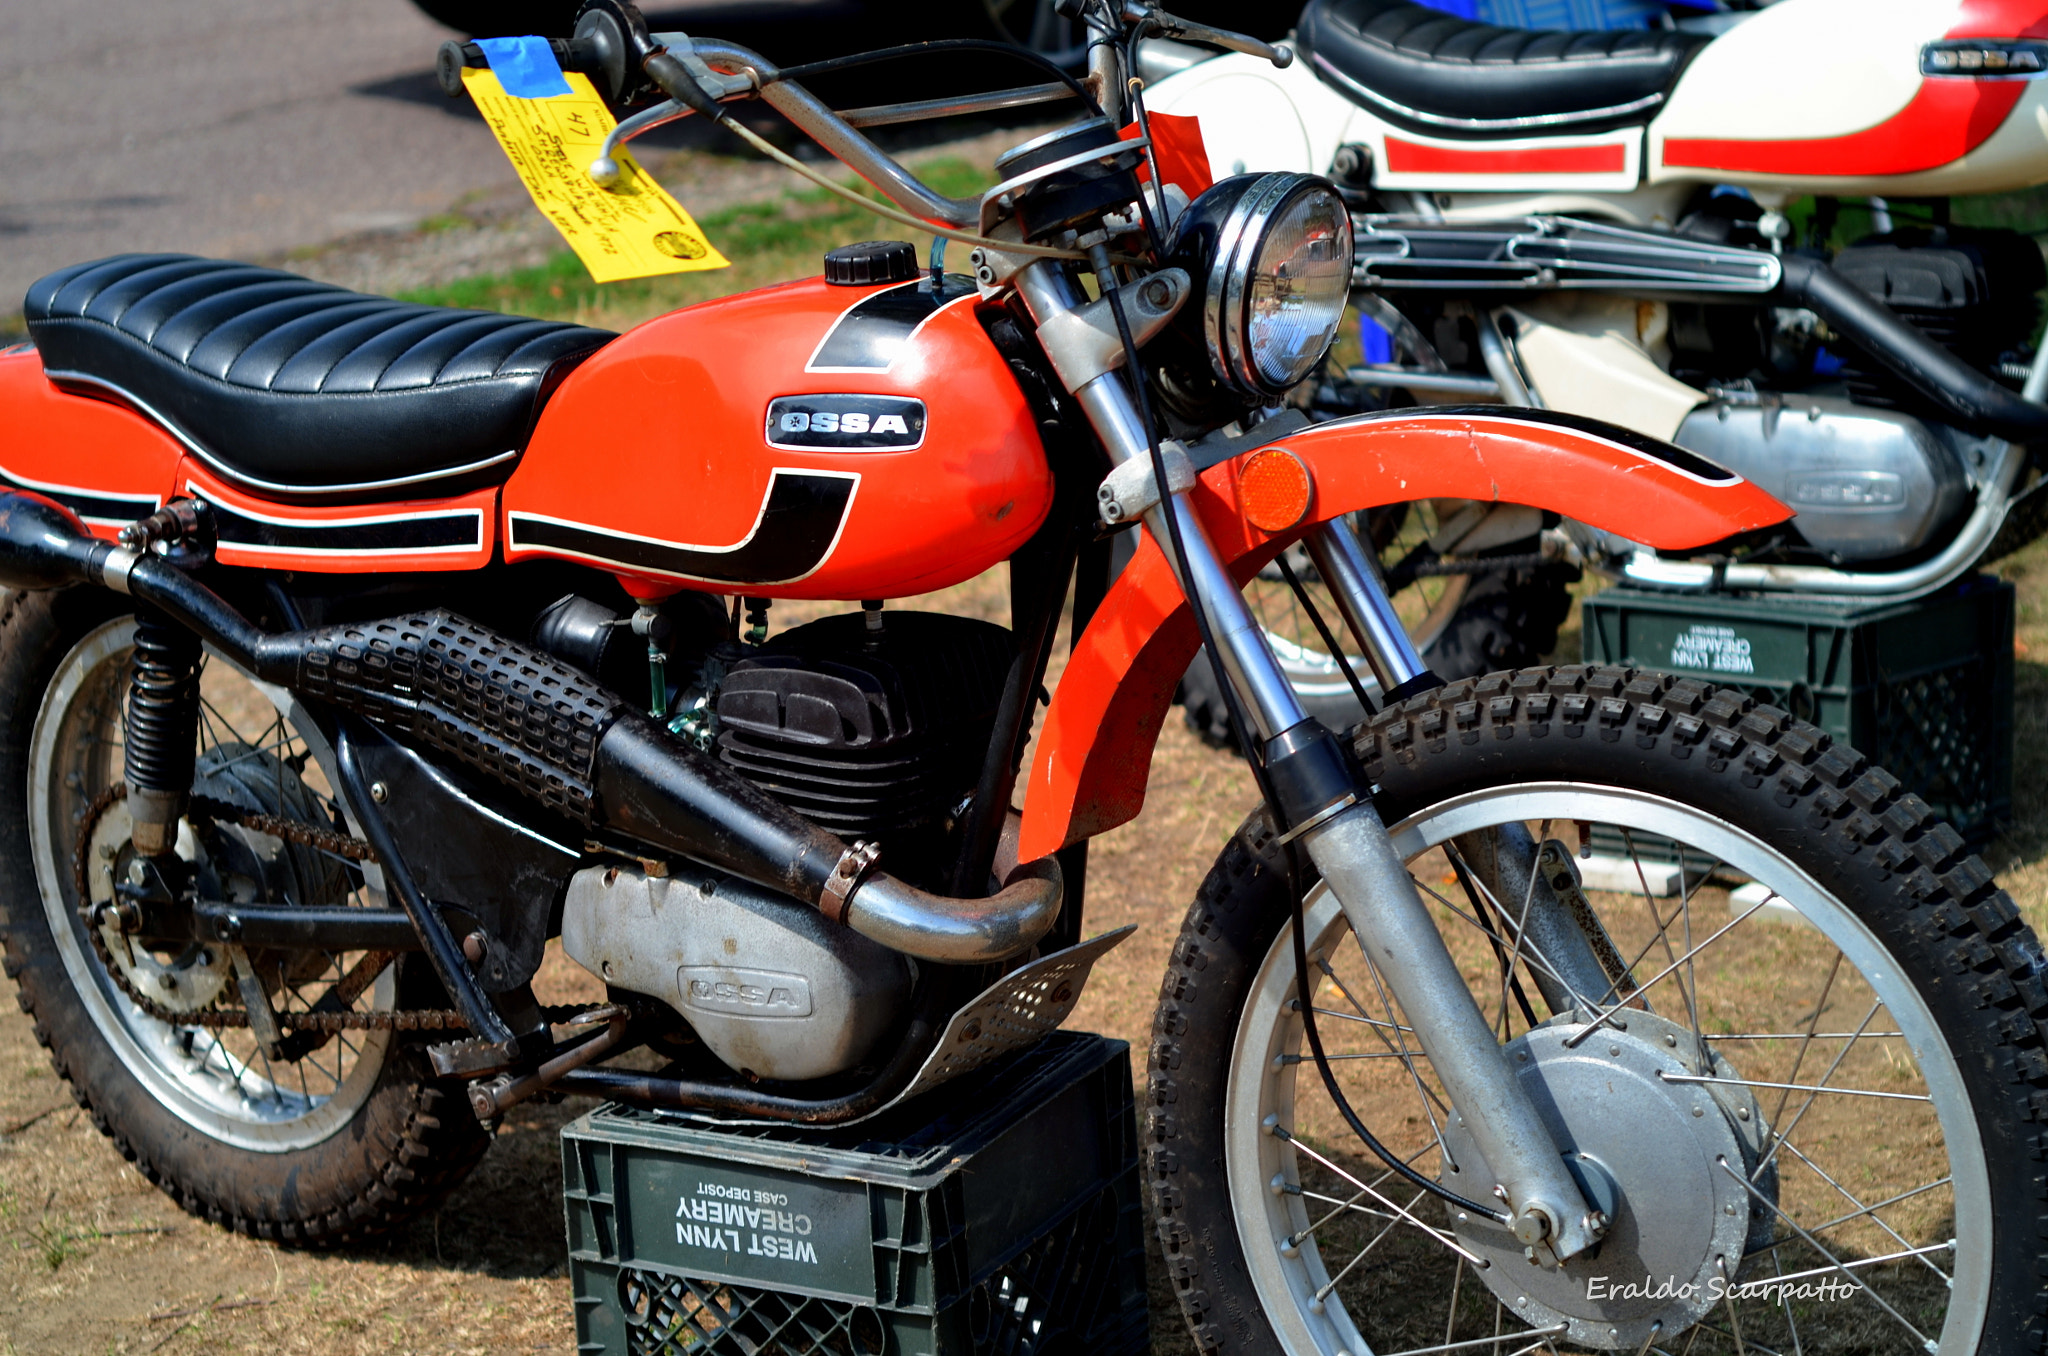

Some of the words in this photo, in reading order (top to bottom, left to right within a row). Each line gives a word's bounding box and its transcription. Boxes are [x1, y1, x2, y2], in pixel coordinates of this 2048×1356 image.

[780, 412, 909, 434] OSSA
[1675, 632, 1751, 655] CREAMERY
[1671, 648, 1709, 669] LYNN
[1712, 654, 1754, 674] WEST
[690, 980, 799, 1009] OSSA
[697, 1181, 751, 1202] DEPOSIT
[754, 1190, 788, 1206] CASE
[675, 1196, 812, 1236] CREAMERY
[675, 1222, 740, 1253] LYNN
[748, 1233, 818, 1265] WEST
